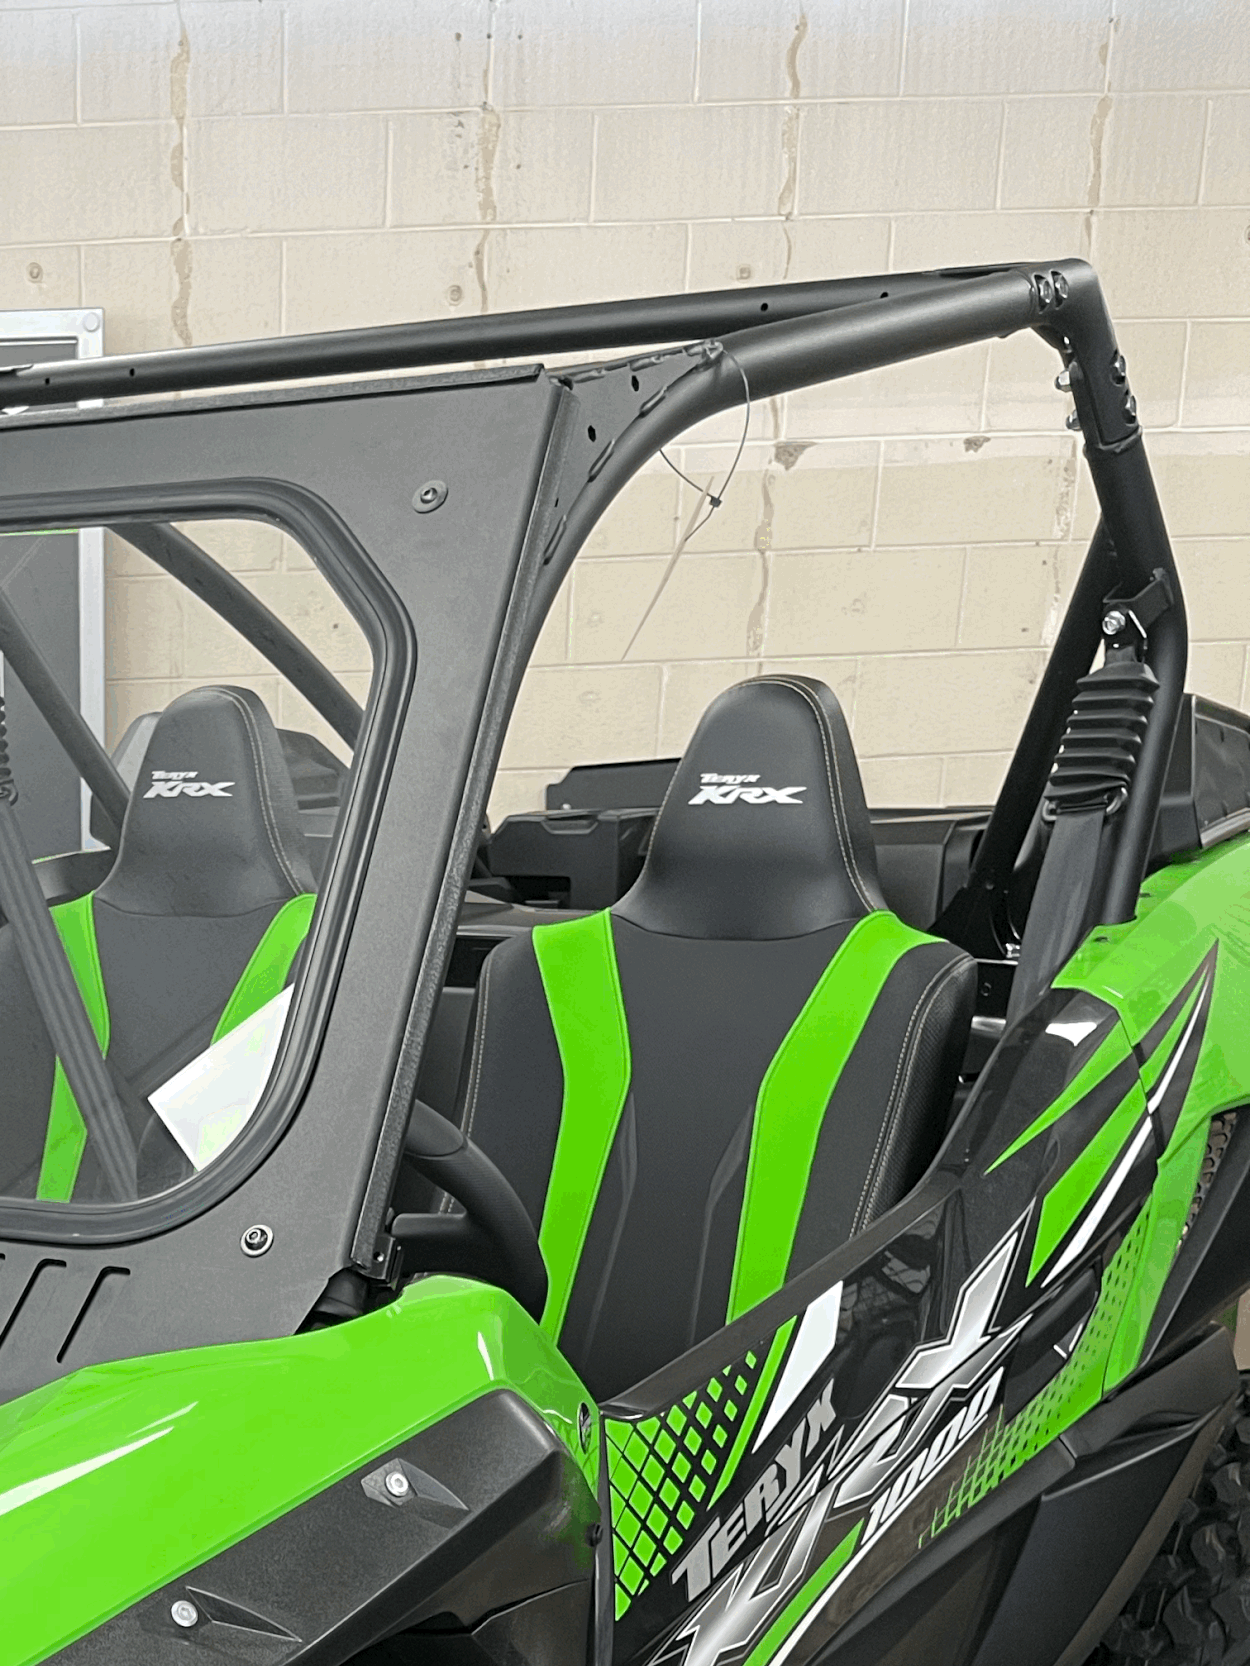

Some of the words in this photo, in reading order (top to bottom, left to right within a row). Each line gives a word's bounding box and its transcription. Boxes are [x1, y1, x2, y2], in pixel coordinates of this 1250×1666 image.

[143, 781, 235, 799] KRX
[688, 785, 807, 805] KRX
[861, 1365, 1005, 1547] 1000
